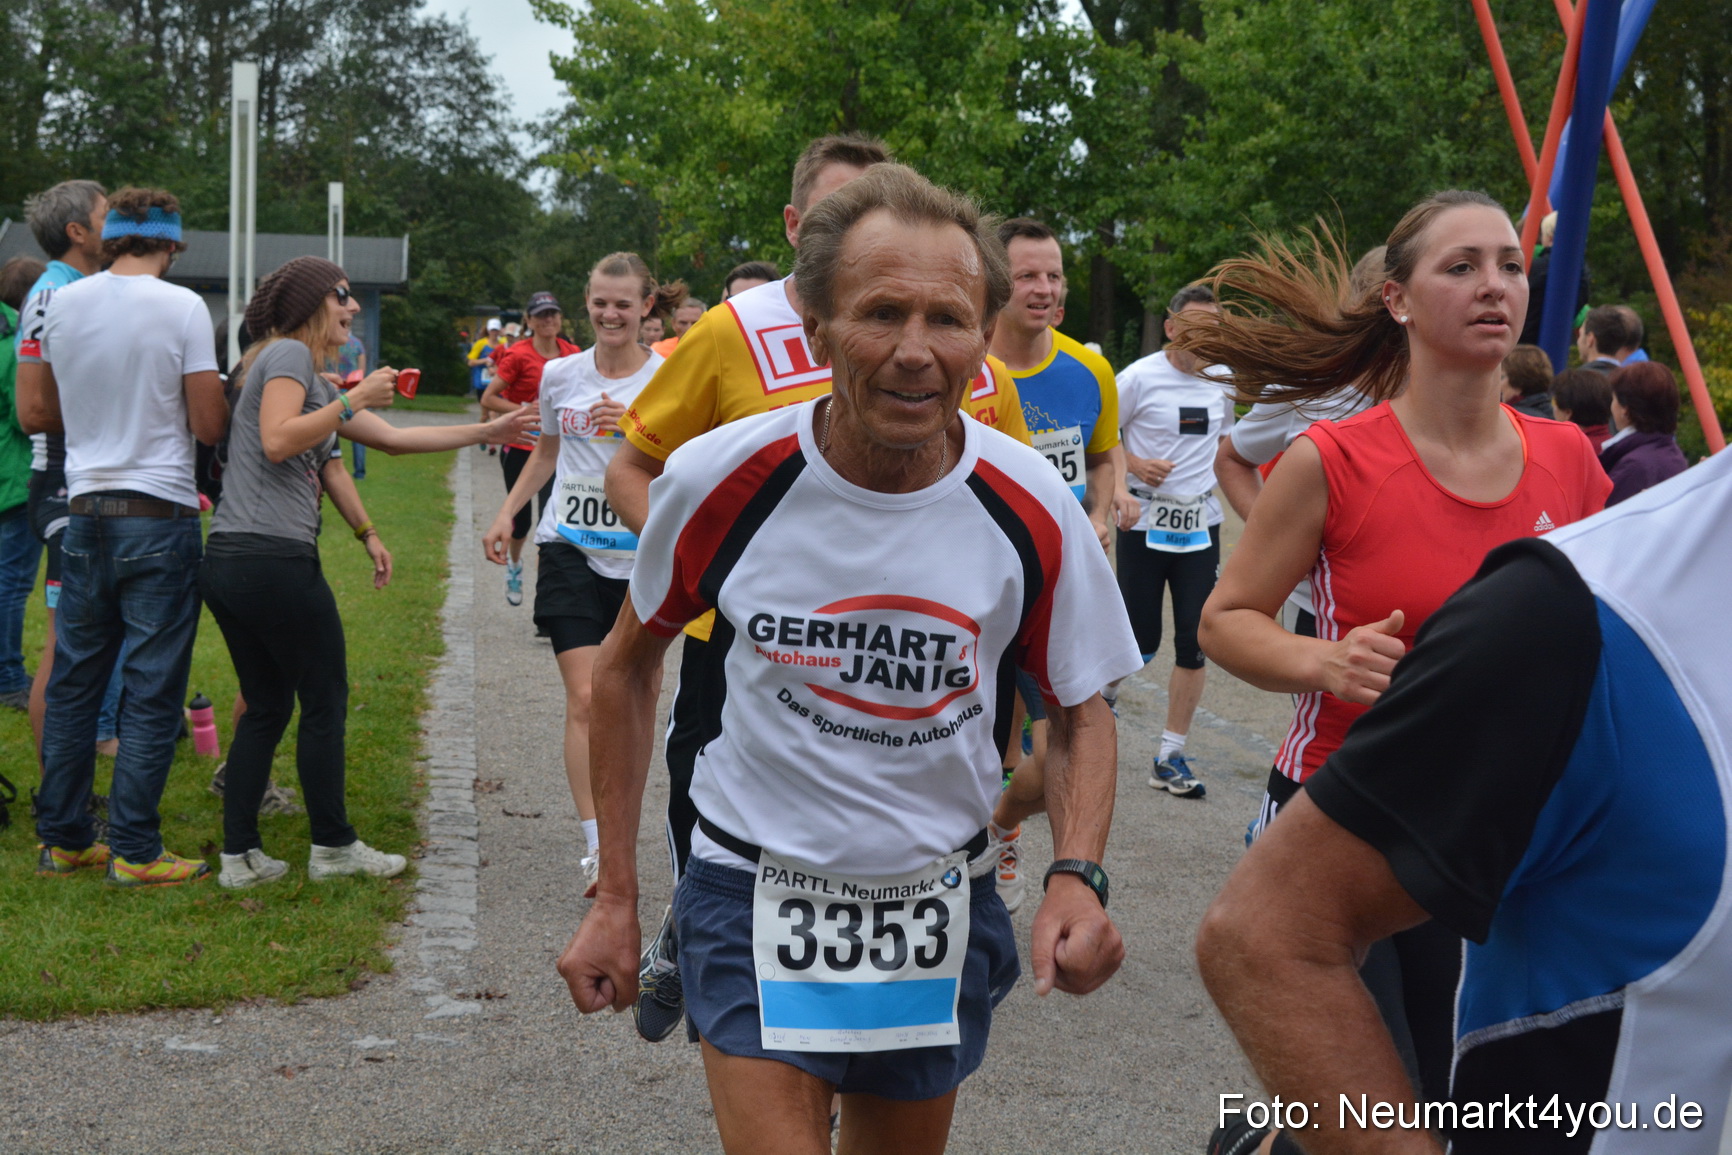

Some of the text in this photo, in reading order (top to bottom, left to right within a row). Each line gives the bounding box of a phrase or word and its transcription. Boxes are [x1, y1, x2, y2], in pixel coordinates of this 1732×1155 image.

[975, 406, 999, 426] GL
[1032, 439, 1070, 452] eumarkt
[562, 482, 605, 494] PARTL Neu
[566, 496, 626, 528] 206
[1155, 506, 1201, 531] 2661
[580, 533, 617, 547] Hanna
[1533, 523, 1555, 532] adidas
[747, 612, 957, 662] GERHART
[755, 644, 842, 668] Autohaus
[839, 655, 971, 693] JÄNIG
[776, 687, 984, 748] Das sportliche Autohaus
[761, 865, 935, 901] PARTL Neumarkt
[777, 897, 950, 972] 3353
